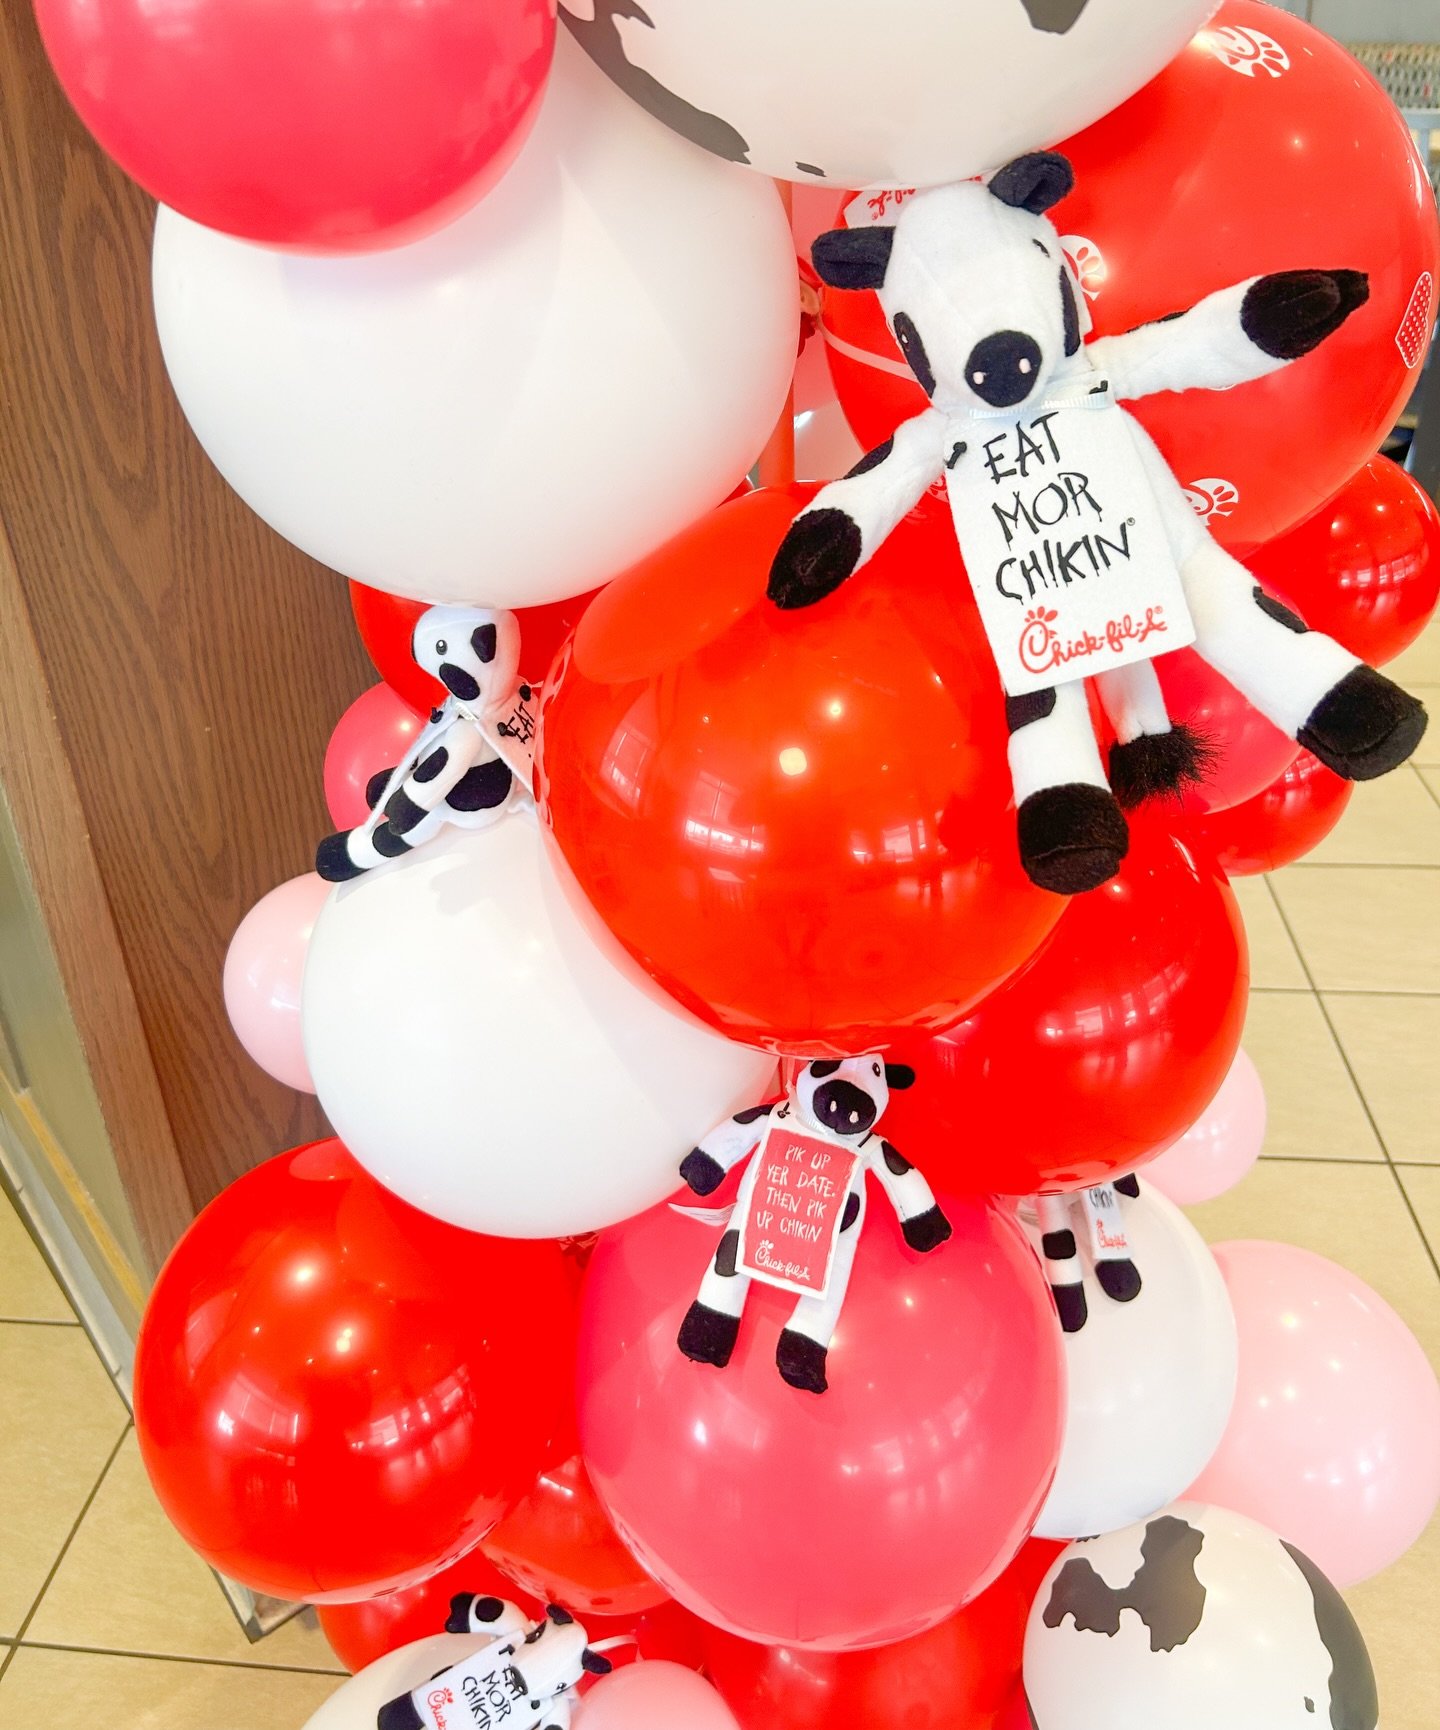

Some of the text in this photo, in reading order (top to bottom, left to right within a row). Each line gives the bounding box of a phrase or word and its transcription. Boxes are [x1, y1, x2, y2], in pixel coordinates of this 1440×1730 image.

[983, 411, 1059, 484] EAT
[991, 472, 1103, 551] MOR
[785, 1145, 831, 1170] PIK UP
[767, 1164, 836, 1198] YER DATE.
[766, 1187, 827, 1219] THEN PIK
[756, 1211, 823, 1243] UP CHIKIN
[481, 1670, 511, 1722] MOR
